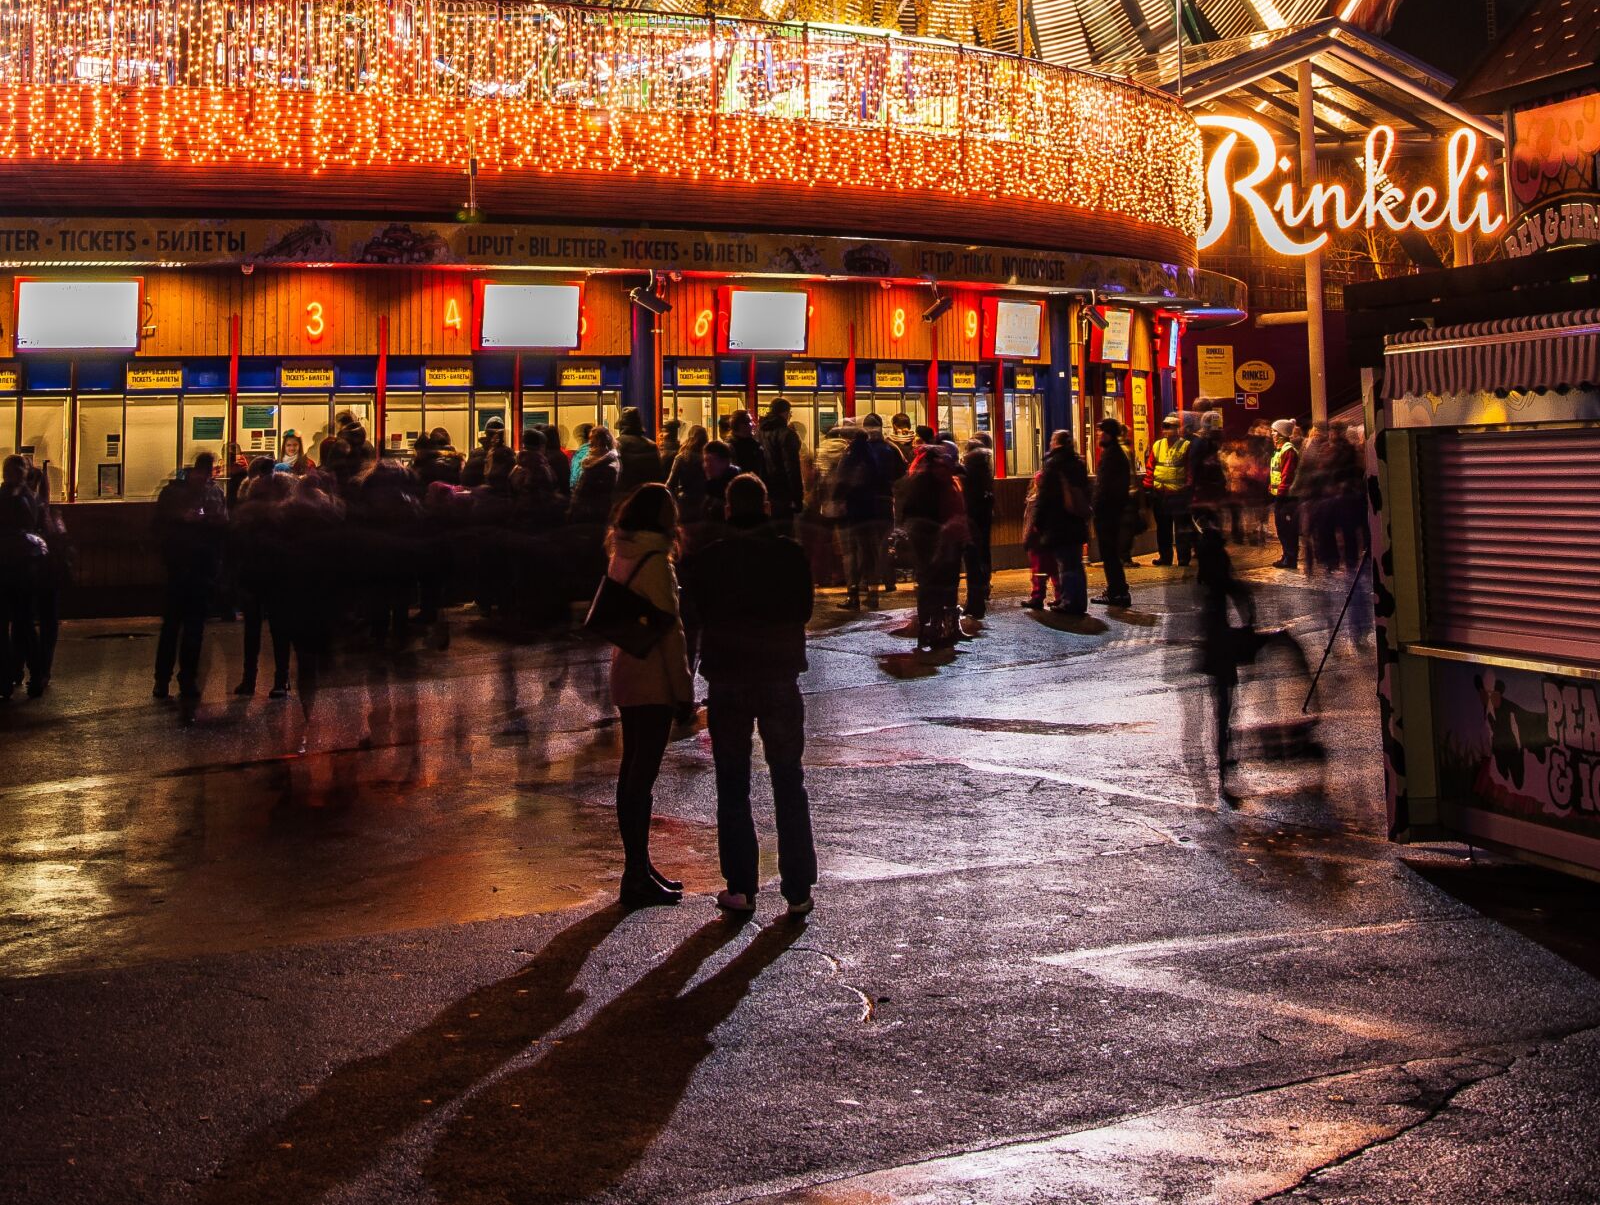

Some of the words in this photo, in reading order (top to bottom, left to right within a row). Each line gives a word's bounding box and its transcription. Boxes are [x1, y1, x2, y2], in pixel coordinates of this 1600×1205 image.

[1195, 116, 1503, 255] Rinkeli
[59, 230, 136, 252] TICKETS
[156, 230, 246, 252] БИЛЕТЫ
[467, 236, 514, 257] LIPUT
[529, 237, 607, 259] BILJETTER
[621, 239, 679, 261] TICKETS
[693, 242, 758, 264] БИЛЕТЫ
[1002, 256, 1064, 281] NOUTOPISTE
[306, 302, 324, 336] 3
[444, 298, 461, 330] 4
[694, 309, 713, 337] 6
[894, 308, 905, 338] 8
[966, 309, 978, 339] 9
[1242, 370, 1269, 381] RINKELI
